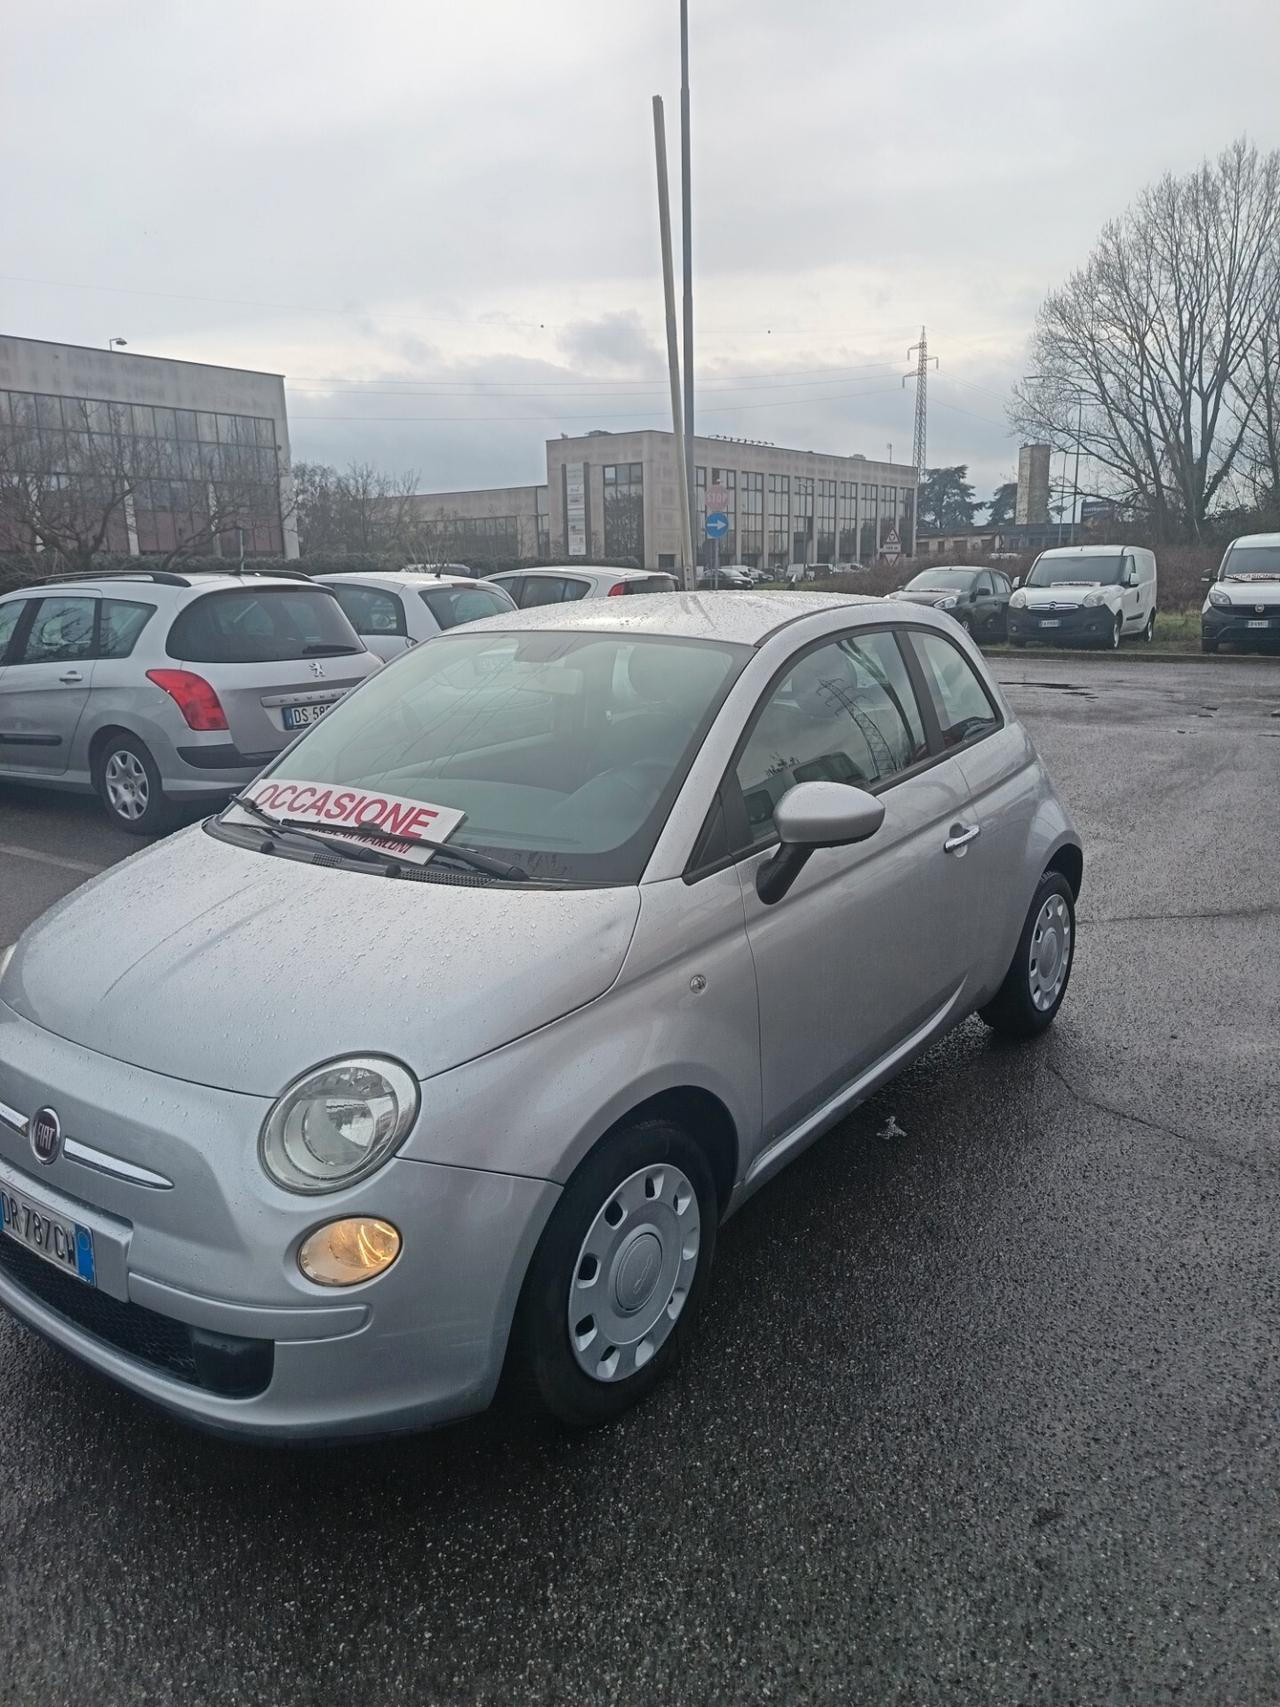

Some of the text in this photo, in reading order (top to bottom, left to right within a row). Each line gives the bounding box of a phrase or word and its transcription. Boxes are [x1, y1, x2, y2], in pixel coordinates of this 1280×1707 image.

[294, 707, 309, 724] DS
[255, 783, 440, 839] OCCASIONE
[37, 1122, 56, 1150] FIAT
